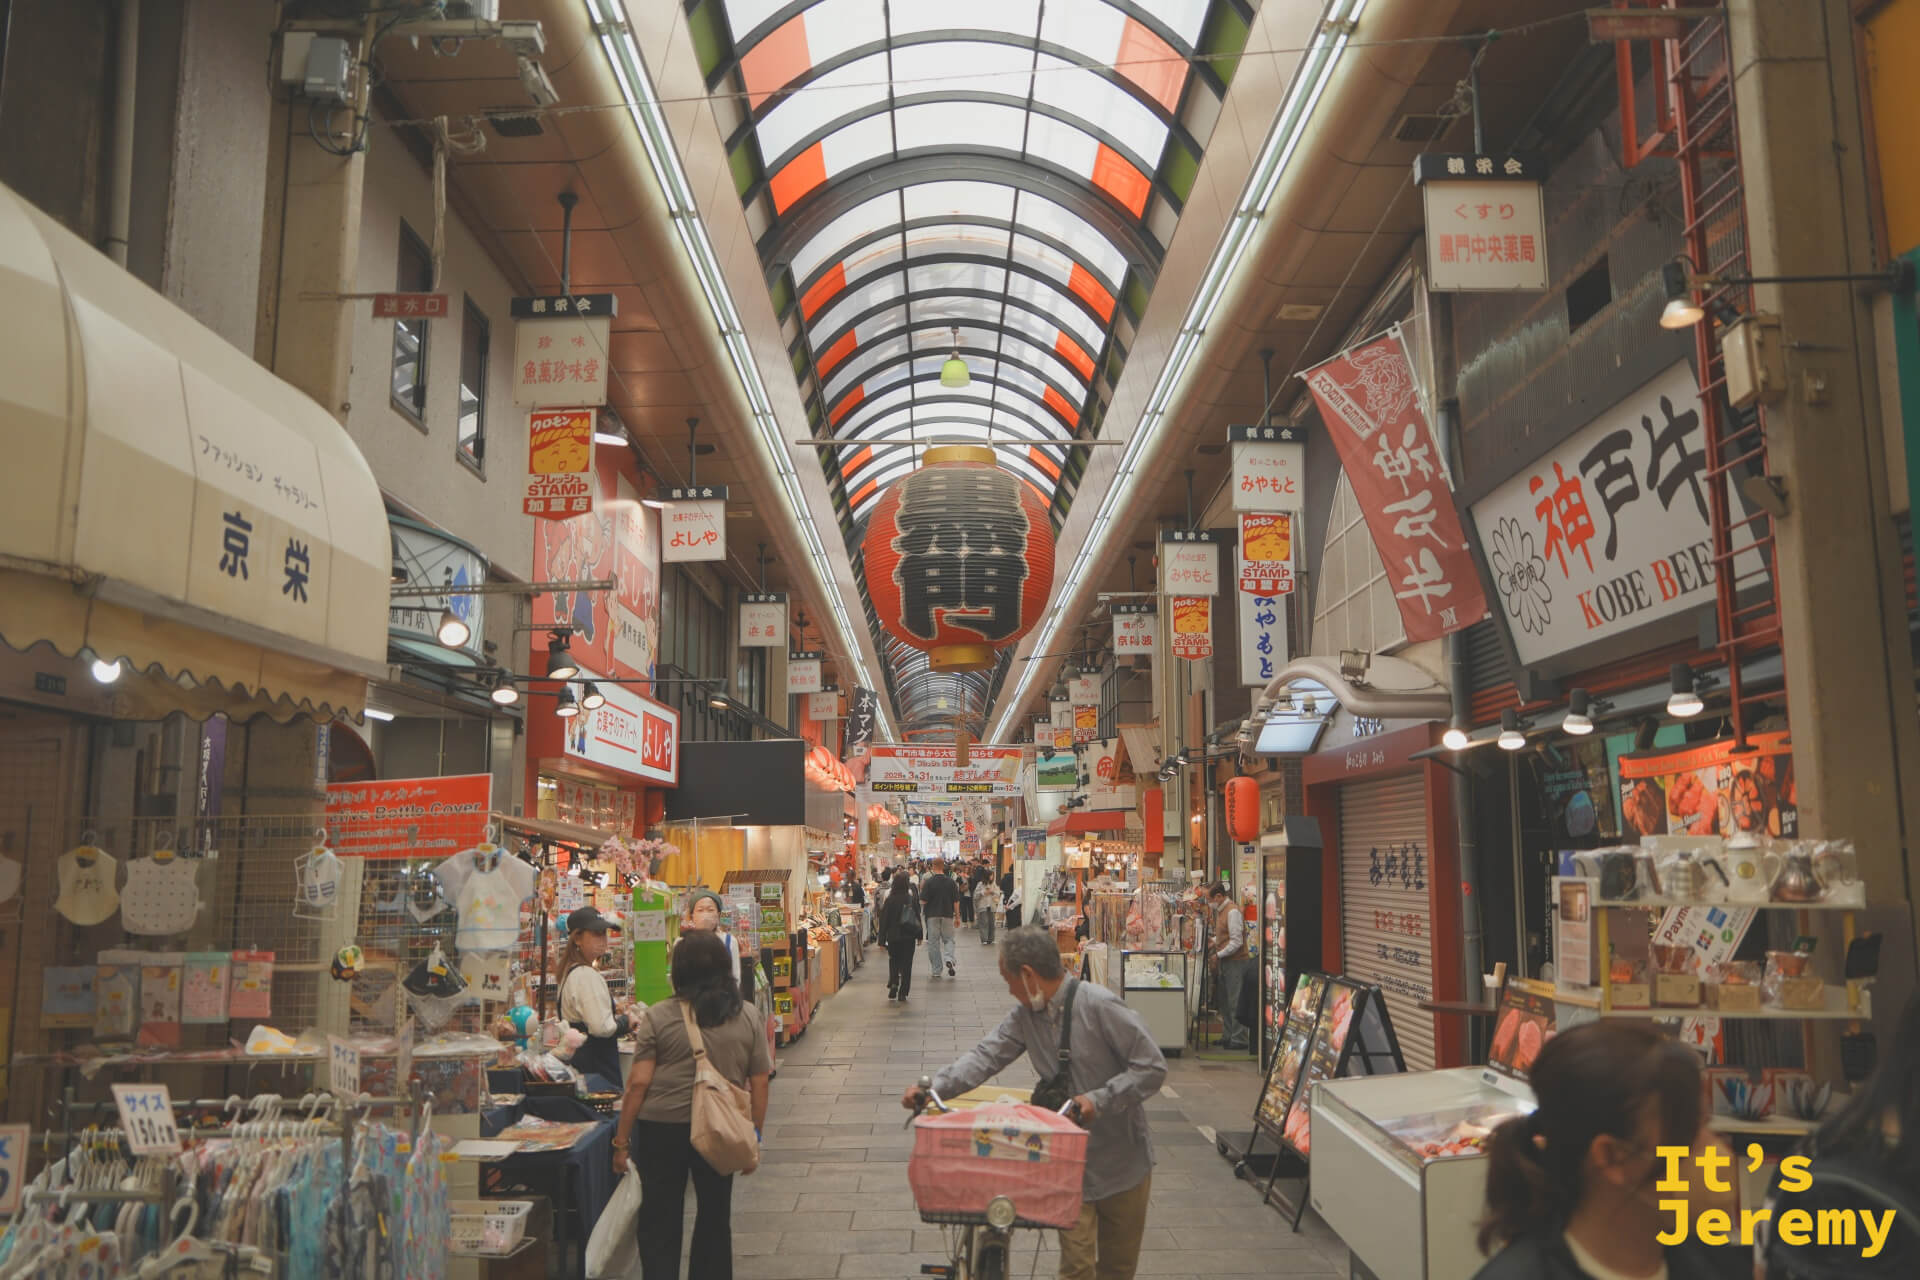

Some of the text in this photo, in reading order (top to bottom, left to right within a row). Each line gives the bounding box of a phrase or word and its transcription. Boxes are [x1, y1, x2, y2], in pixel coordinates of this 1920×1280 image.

[1454, 203, 1515, 220] くすり
[1440, 234, 1536, 263] 黒門中央薬局
[531, 415, 571, 433] クロモン
[533, 474, 581, 485] フレッシュ
[1241, 475, 1296, 494] みやもと
[1529, 393, 1711, 580] 神戸牛
[528, 483, 589, 497] STAMP
[527, 498, 588, 512] 加盟店
[1244, 518, 1274, 528] クロモン
[670, 530, 718, 547] よしや
[890, 467, 1032, 642] 黒門
[1243, 568, 1290, 578] STAMP
[1247, 560, 1284, 569] フレッシュ
[1170, 568, 1214, 583] みやもと
[1576, 537, 1721, 630] KOBE BEE
[1243, 579, 1290, 591] 加盟店
[1174, 638, 1209, 646] STAMP
[596, 711, 672, 768] お菓子のデパート よしや
[375, 801, 424, 819] Bottle
[430, 801, 482, 816] Cover
[334, 1045, 357, 1065] サイズ
[124, 1093, 165, 1112] サイズ
[130, 1118, 176, 1144] 150cm
